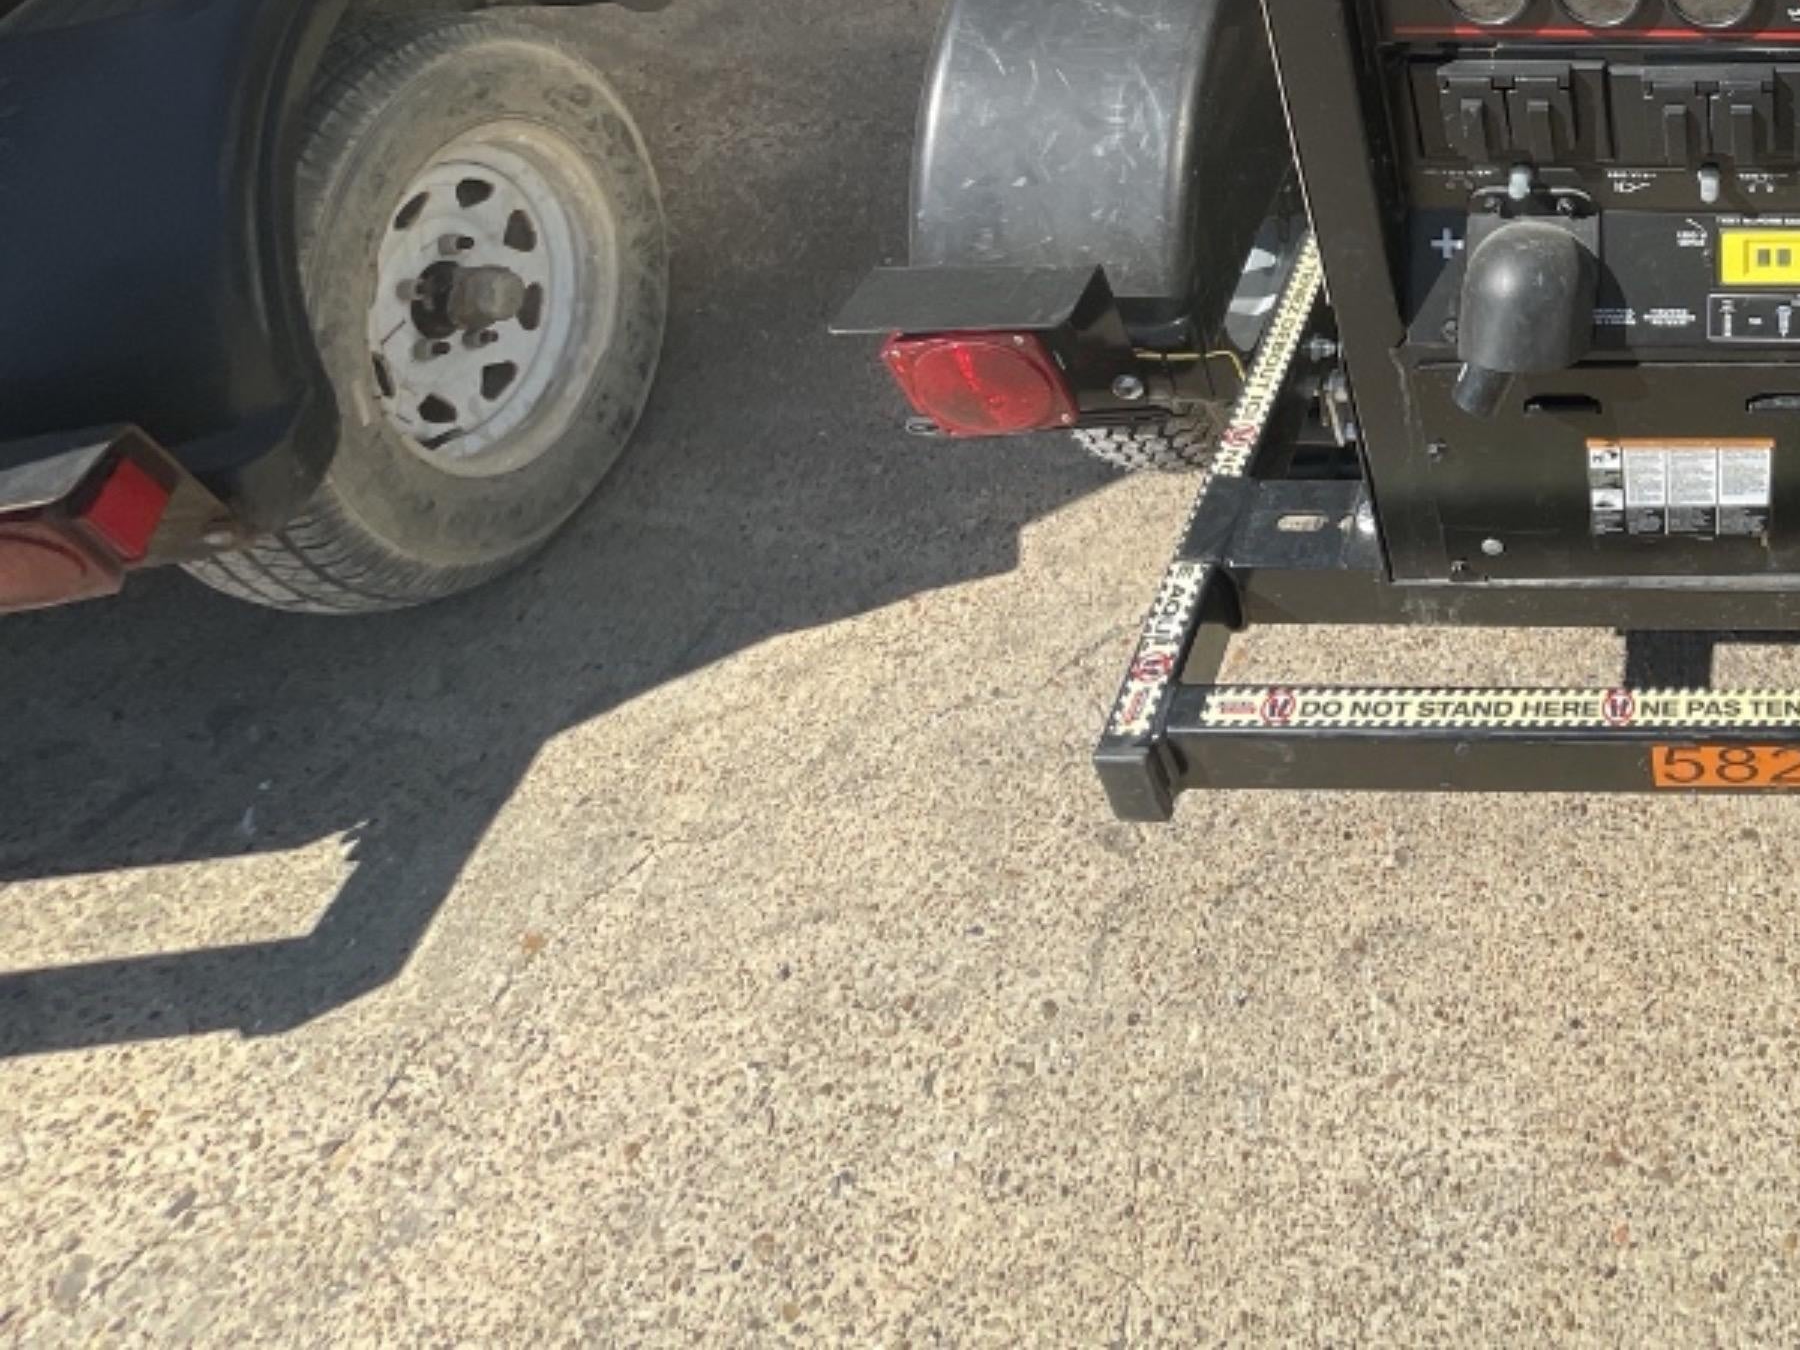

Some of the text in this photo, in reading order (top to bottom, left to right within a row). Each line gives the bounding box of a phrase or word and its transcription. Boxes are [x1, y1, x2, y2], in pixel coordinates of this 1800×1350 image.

[1299, 700, 1599, 718] DO NOT STAND HERE
[1640, 701, 1680, 717] NE
[1686, 701, 1741, 717] PAS
